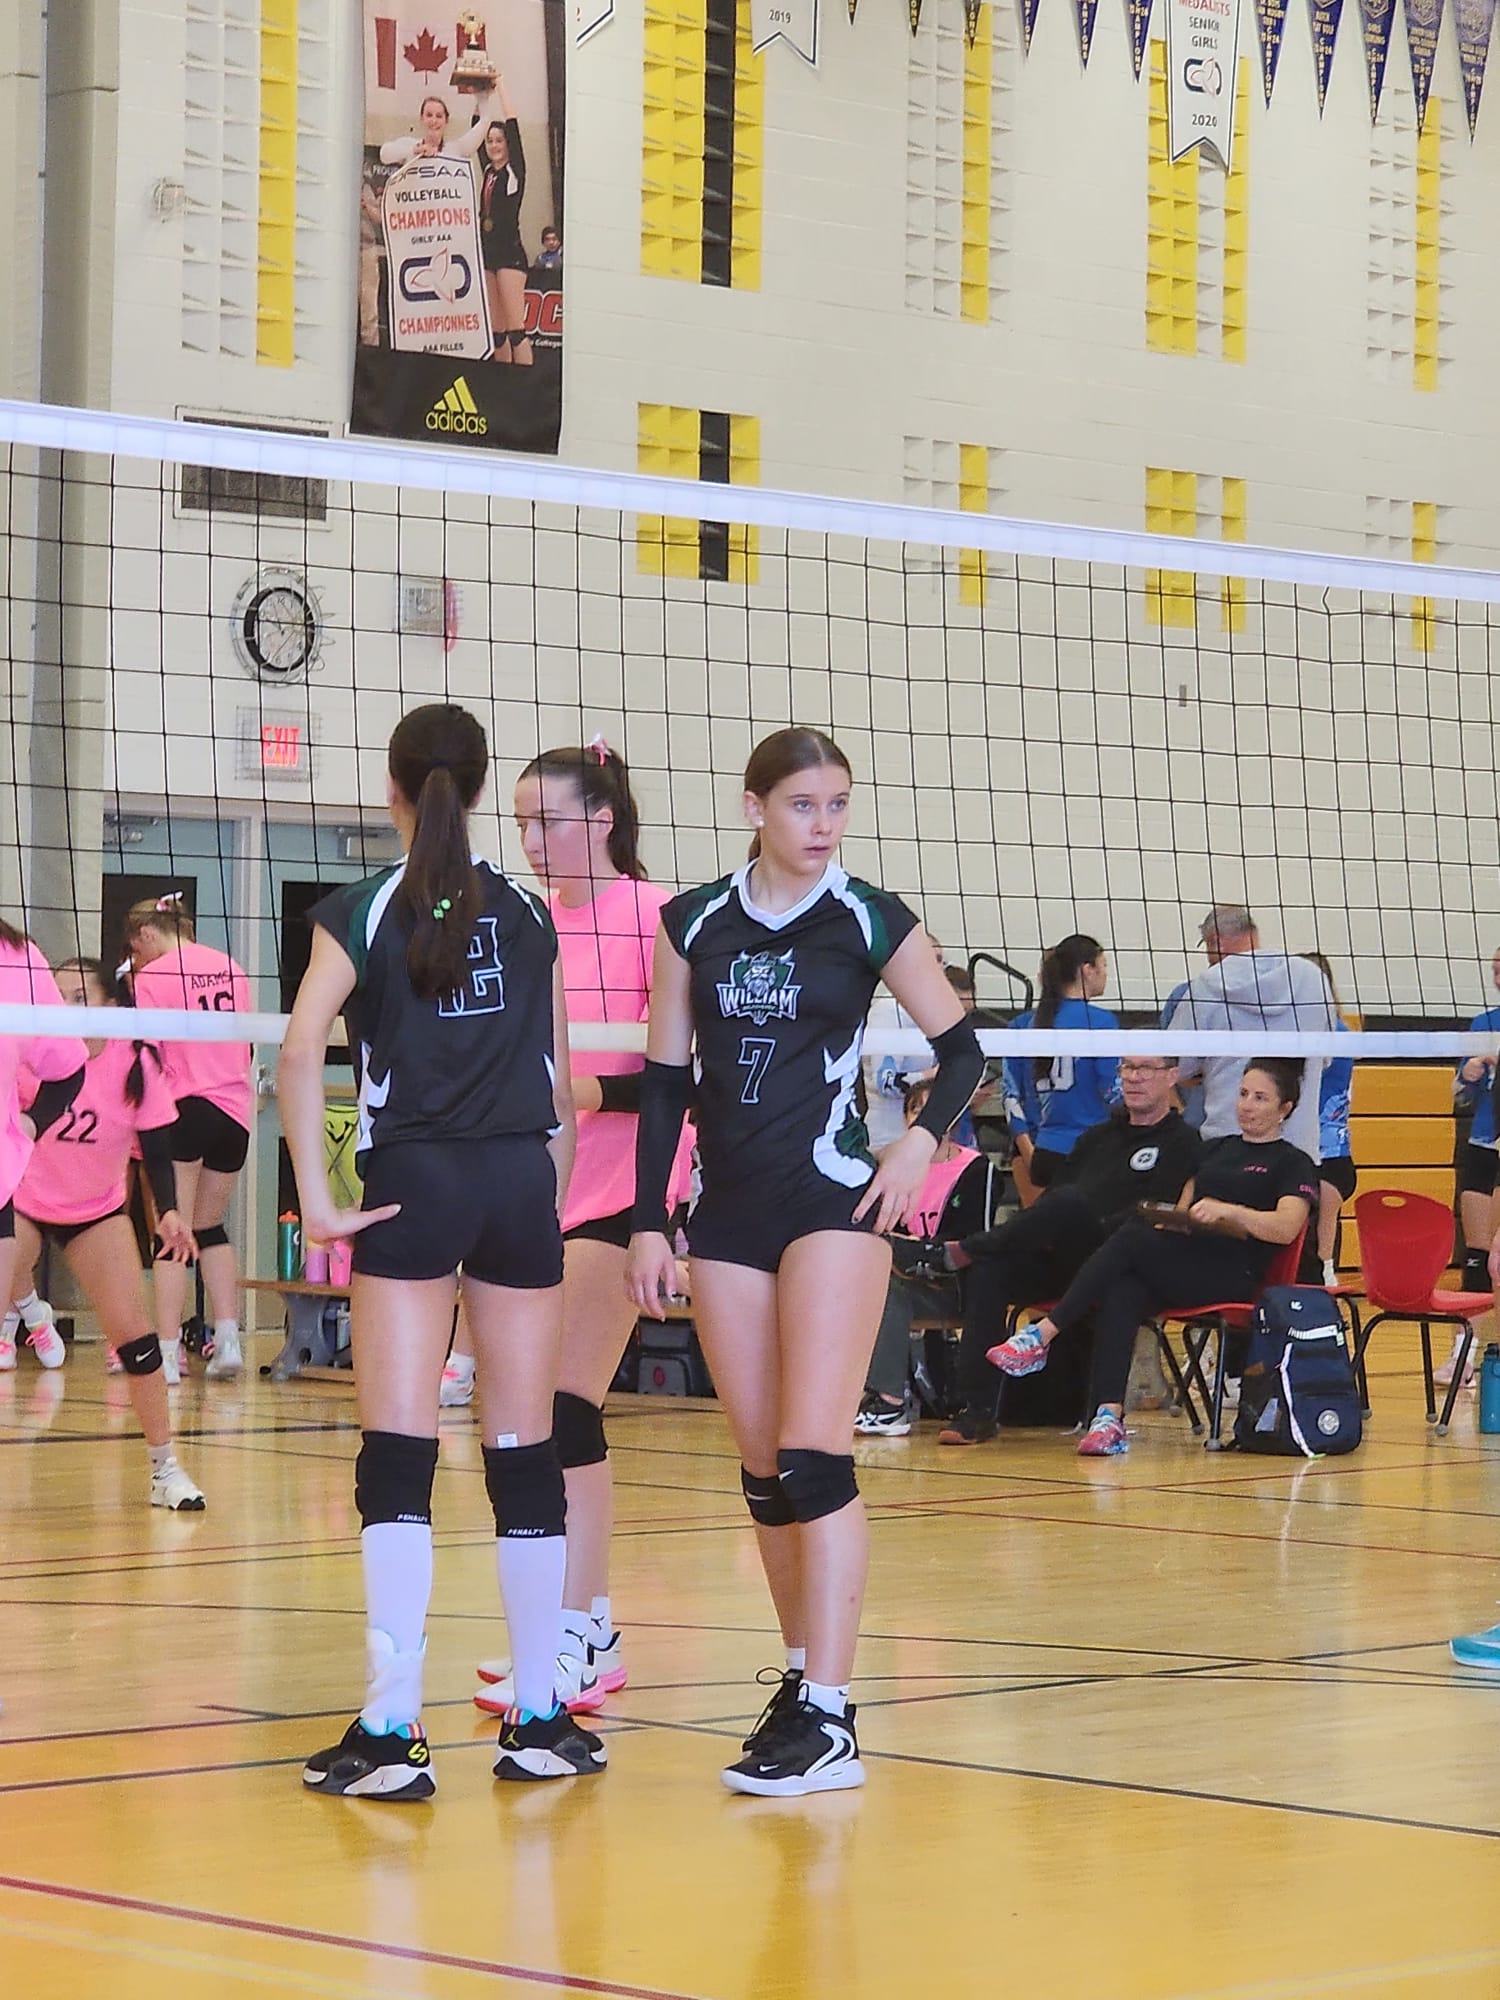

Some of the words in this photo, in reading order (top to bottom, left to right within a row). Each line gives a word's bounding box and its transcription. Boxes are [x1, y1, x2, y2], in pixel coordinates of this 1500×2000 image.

[768, 8, 792, 24] 2019
[1189, 16, 1220, 32] SENIOR
[1191, 35, 1218, 49] GIRLS
[1191, 114, 1218, 127] 2020
[394, 188, 462, 203] VOLLEYBALL
[389, 207, 471, 231] CHAMPIONS
[436, 233, 452, 242] AAA
[439, 342, 464, 351] FILLES
[425, 411, 488, 435] adidas
[261, 725, 300, 766] EXIT
[738, 1037, 777, 1104] 7
[57, 1107, 97, 1143] 22
[397, 1513, 429, 1523] PENALTY
[506, 1527, 546, 1536] PENALTY
